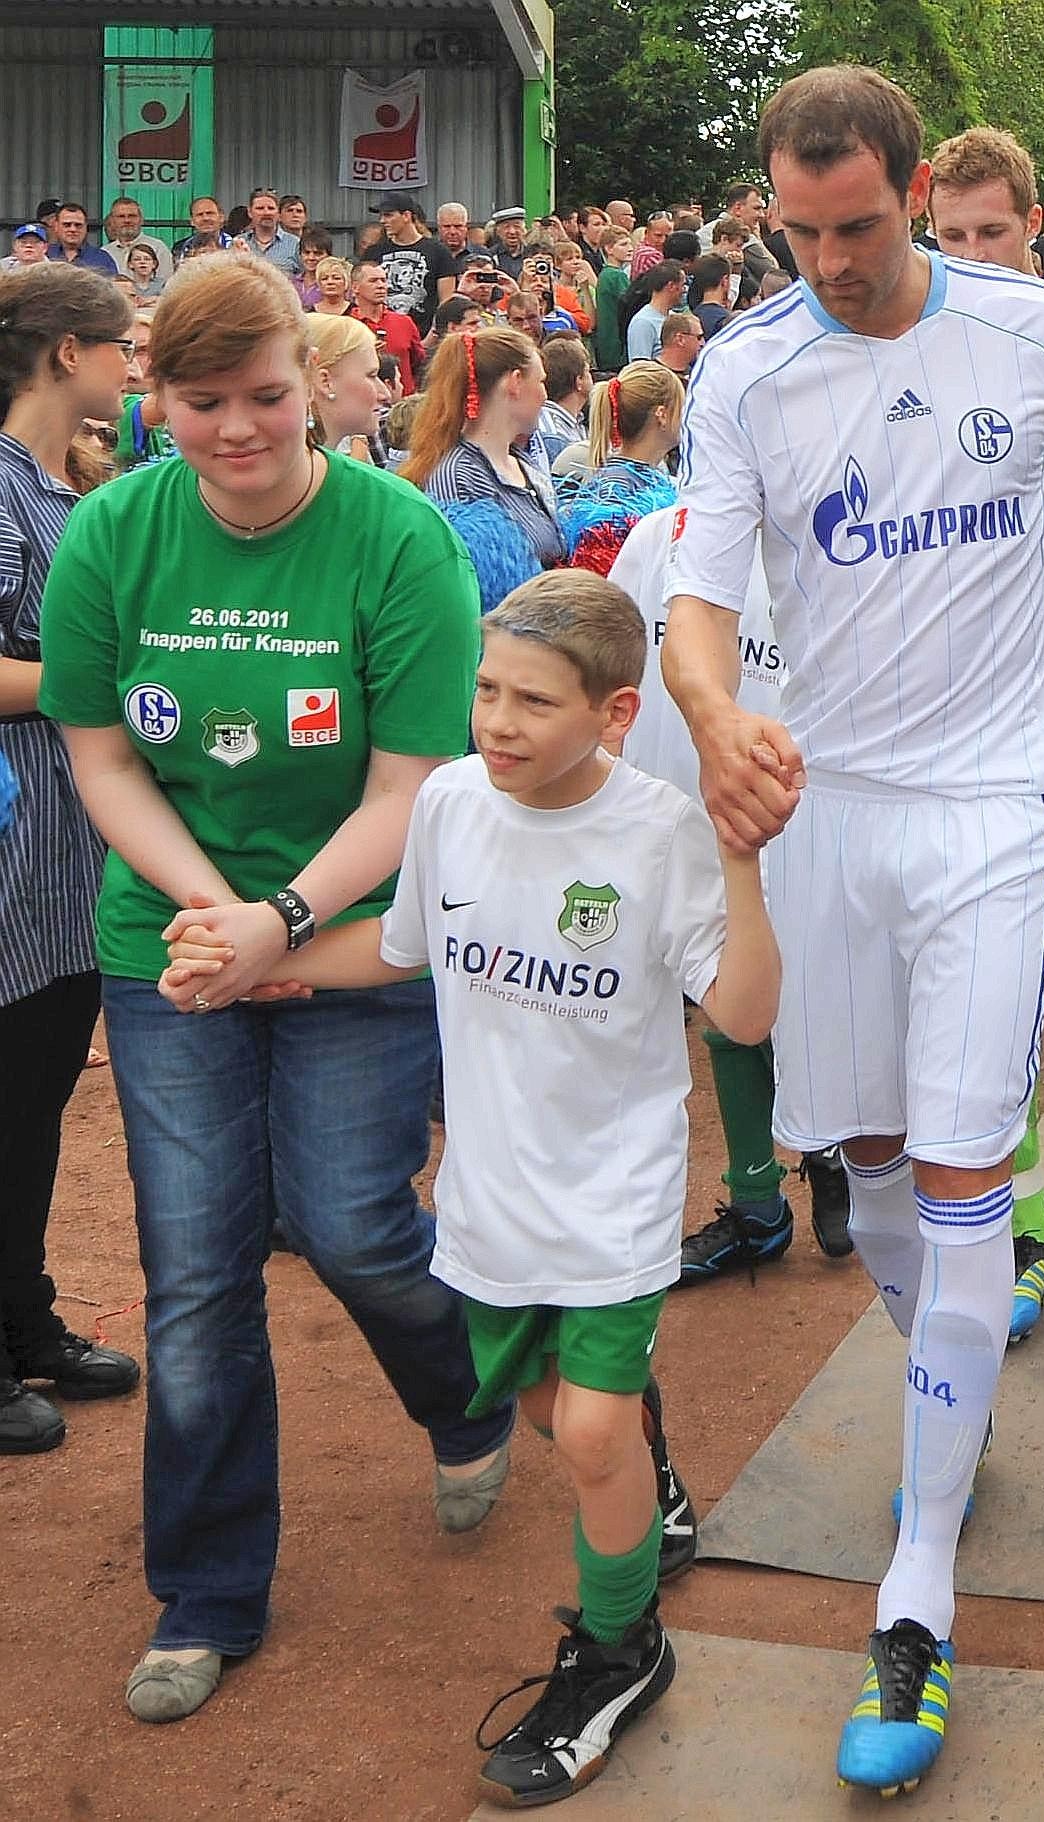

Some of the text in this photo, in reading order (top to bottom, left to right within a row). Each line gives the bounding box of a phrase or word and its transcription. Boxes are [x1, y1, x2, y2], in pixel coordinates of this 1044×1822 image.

[138, 162, 188, 183] BCE
[371, 160, 419, 182] BCE
[886, 405, 932, 422] adidas
[879, 496, 1027, 561] GAZPROM
[189, 607, 289, 628] 26.06.2011
[139, 628, 340, 657] Knappen für Knappen
[304, 729, 338, 743] BCE
[446, 936, 620, 999] RO/ZINSO
[469, 978, 609, 1023] Finanzenstleistung
